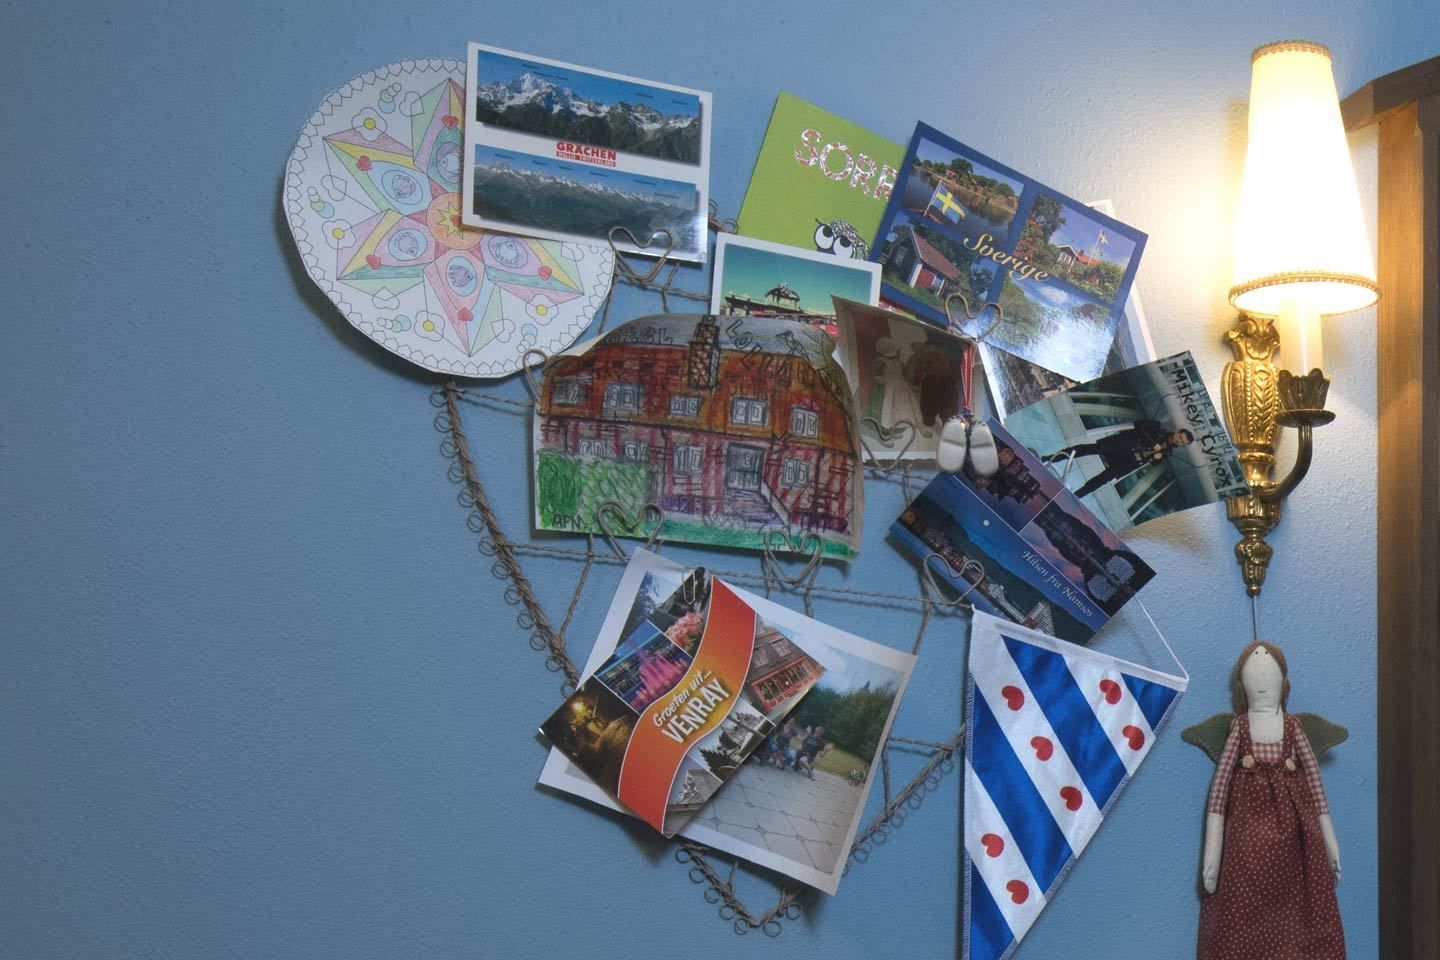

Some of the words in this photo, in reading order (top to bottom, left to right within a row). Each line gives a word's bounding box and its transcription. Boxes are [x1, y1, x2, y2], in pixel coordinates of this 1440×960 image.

[963, 233, 1049, 282] Sverige
[1022, 550, 1049, 577] Hilsen
[1046, 574, 1062, 589] fra
[1062, 586, 1094, 617] Namsos
[653, 688, 690, 727] Groeten
[661, 677, 730, 744] VENRAY
